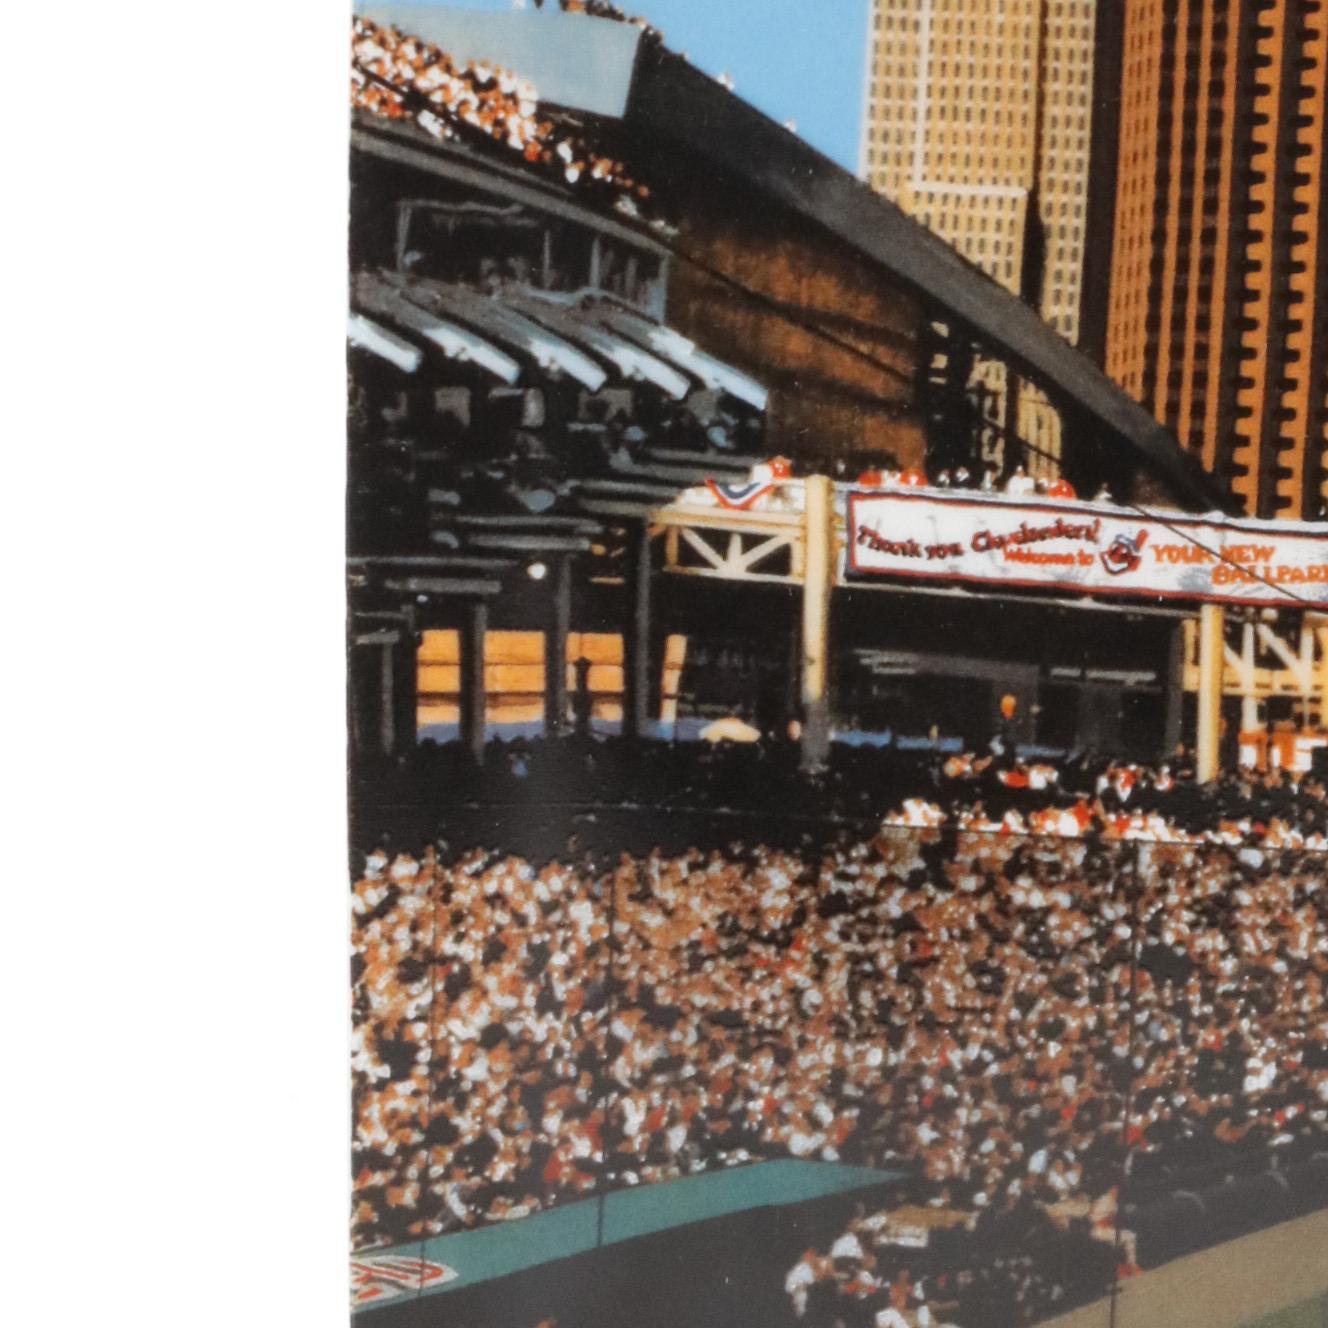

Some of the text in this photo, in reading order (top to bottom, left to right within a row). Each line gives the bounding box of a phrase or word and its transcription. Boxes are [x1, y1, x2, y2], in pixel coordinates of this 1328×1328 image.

[925, 542, 964, 561] you
[1077, 548, 1094, 566] to
[1151, 544, 1278, 564] YOUR NEW
